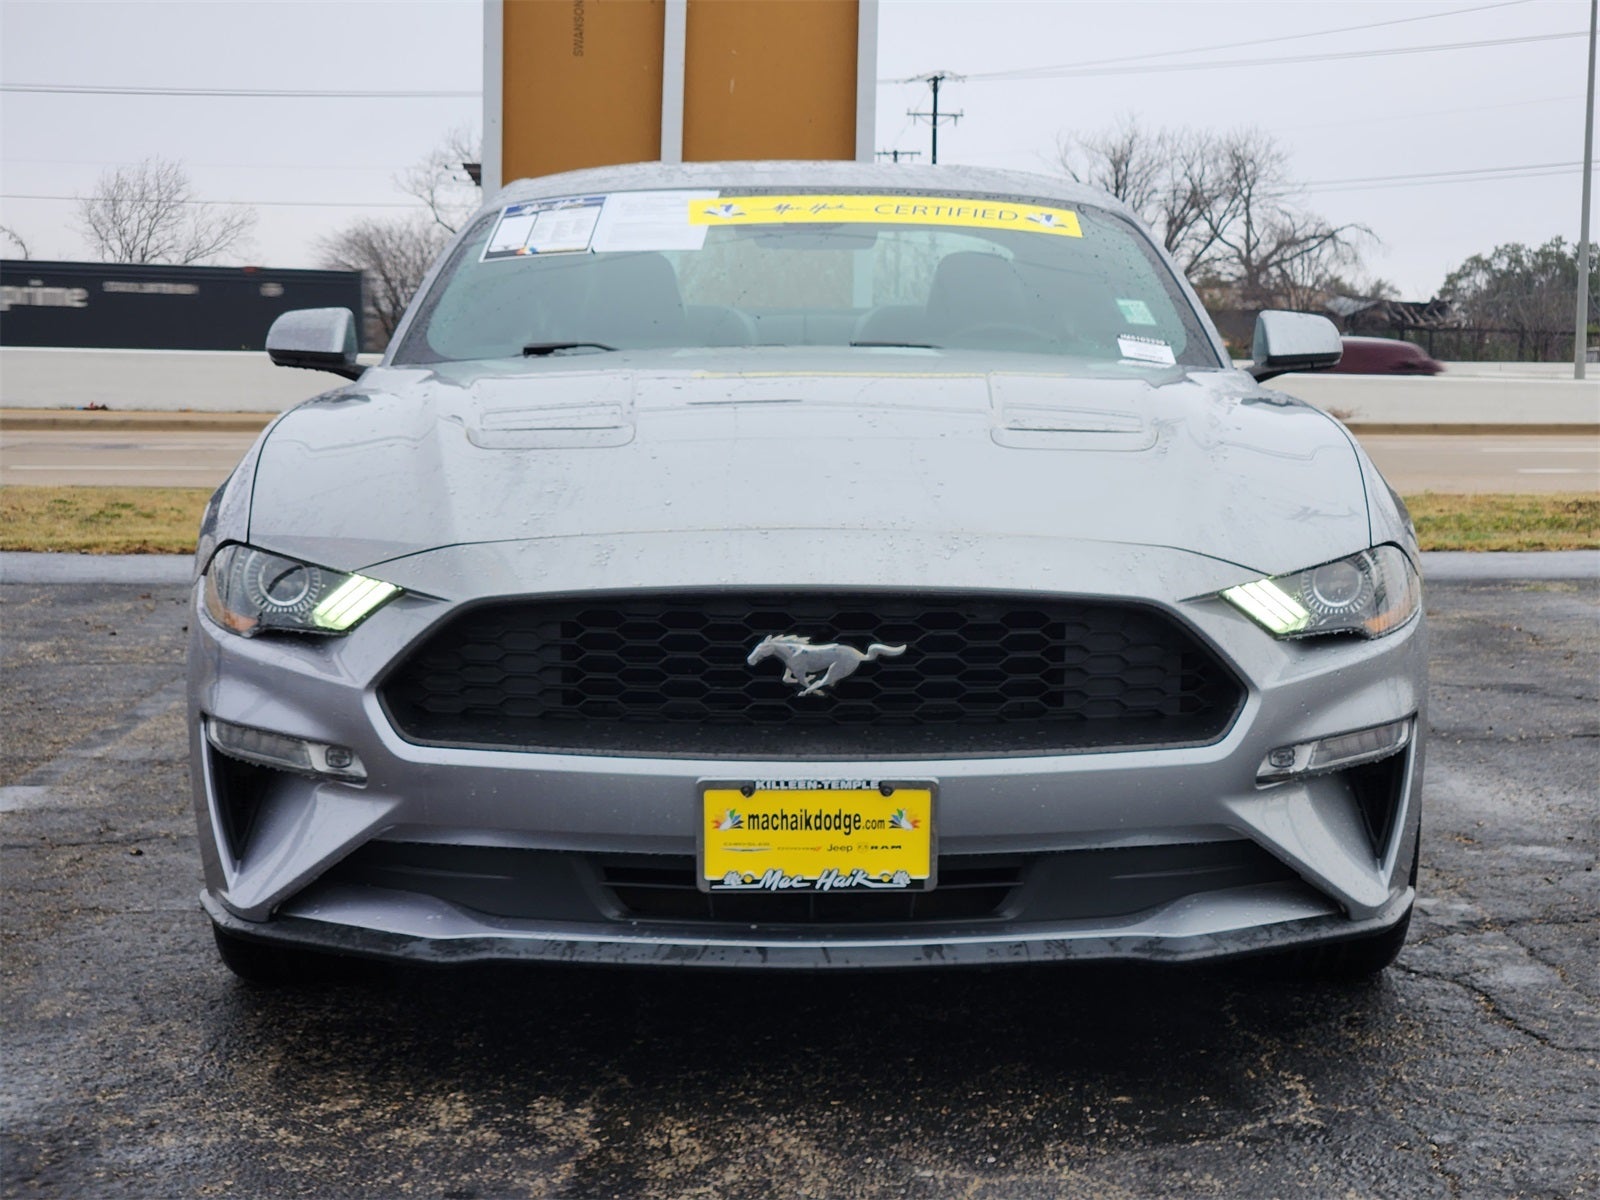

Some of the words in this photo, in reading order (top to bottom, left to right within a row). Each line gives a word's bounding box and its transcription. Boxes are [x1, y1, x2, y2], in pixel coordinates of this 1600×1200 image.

[874, 203, 1018, 221] CERTIFIED
[747, 808, 886, 835] machaikdodge.com
[827, 844, 853, 853] Jeep
[759, 869, 809, 892] Mac
[815, 869, 875, 892] Haik
